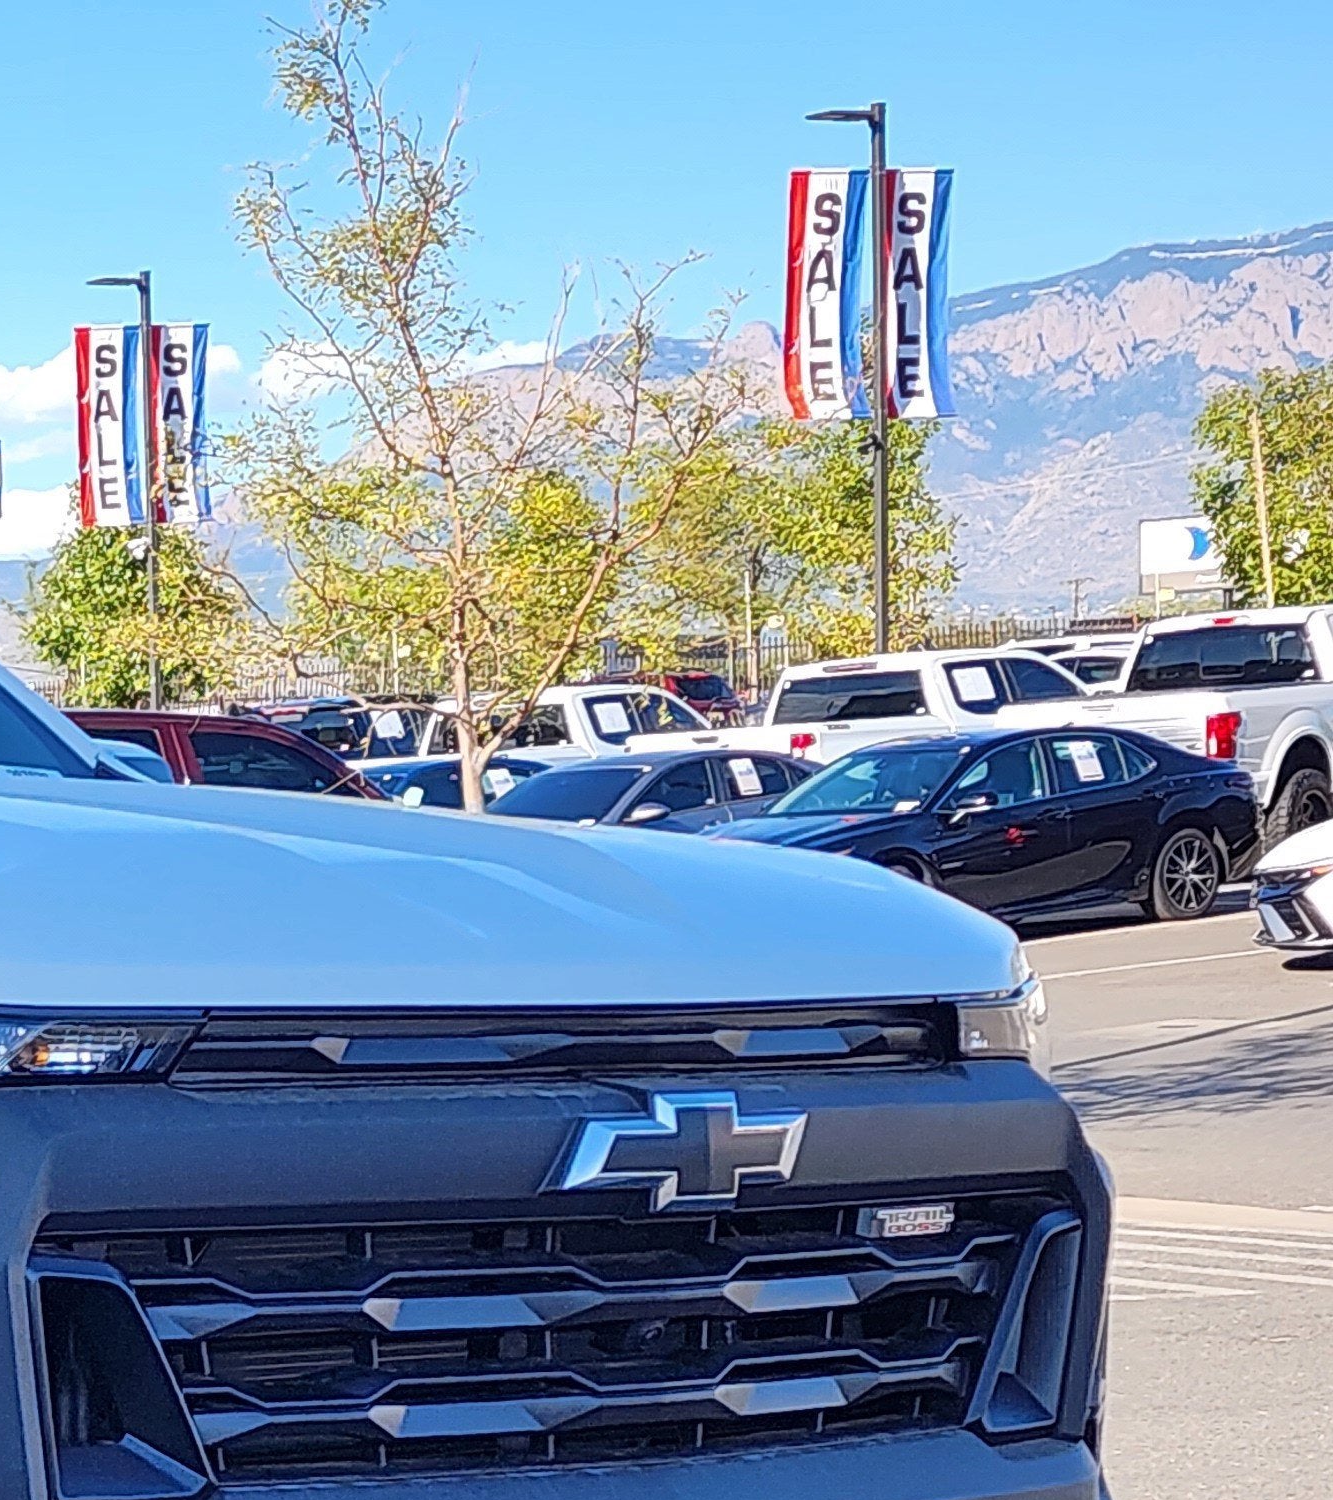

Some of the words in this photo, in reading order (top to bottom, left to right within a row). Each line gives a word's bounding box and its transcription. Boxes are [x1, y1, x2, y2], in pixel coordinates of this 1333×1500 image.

[806, 192, 843, 400] SALE
[893, 192, 927, 398] SALE
[94, 344, 121, 509] SALE
[878, 1208, 953, 1222] TRAIL
[887, 1222, 943, 1234] BOSS
